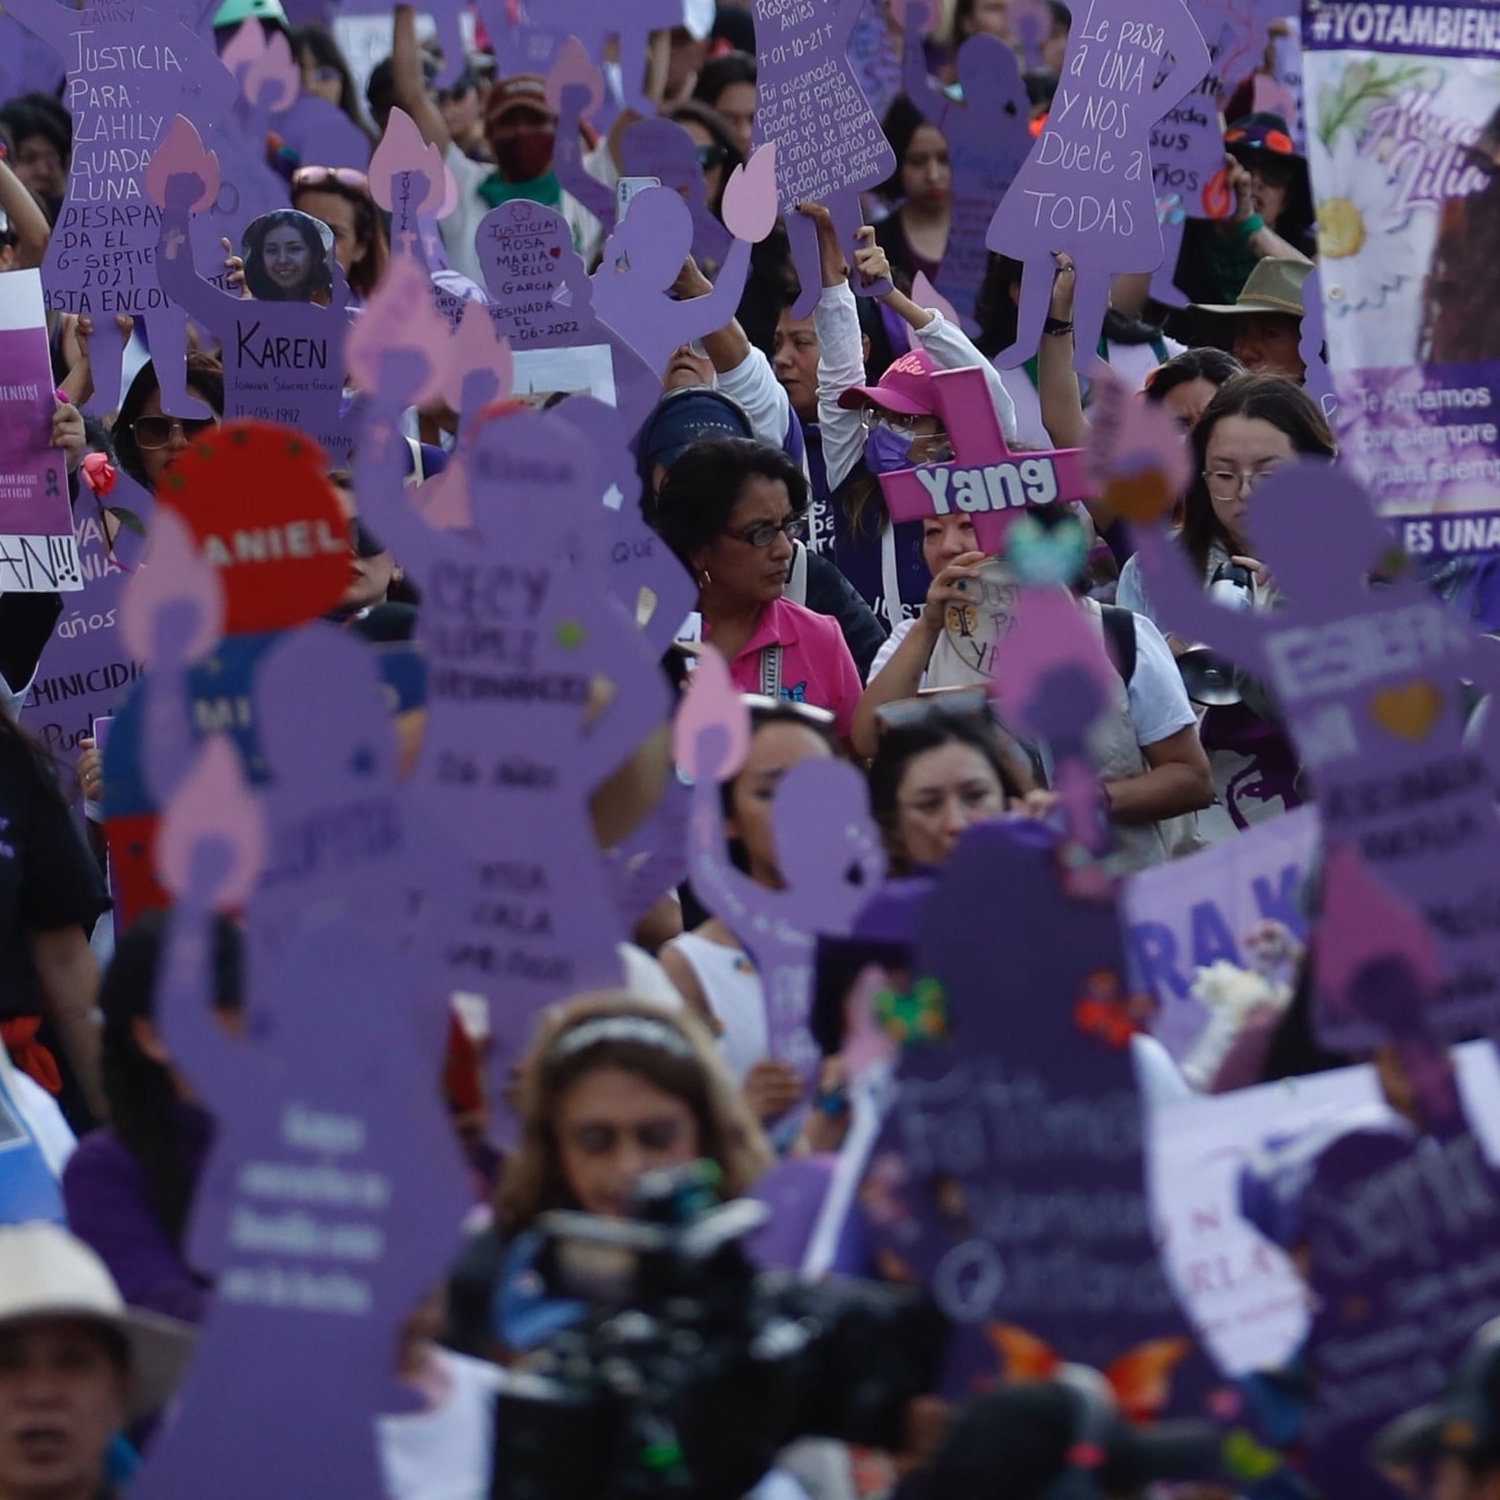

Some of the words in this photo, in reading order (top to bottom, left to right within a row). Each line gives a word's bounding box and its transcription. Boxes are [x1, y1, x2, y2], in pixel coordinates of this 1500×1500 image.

[1118, 21, 1164, 57] pasa
[759, 83, 778, 103] Fui
[781, 57, 838, 96] asesinada
[1071, 43, 1088, 77] a
[1098, 51, 1145, 94] UNA
[757, 106, 778, 127] por
[813, 70, 847, 103] pareja
[73, 113, 163, 143] ZAHILY
[764, 111, 797, 141] padre
[800, 104, 814, 121] de
[1084, 103, 1128, 139] NOS
[1037, 132, 1114, 174] Duele
[1131, 147, 1142, 181] a
[70, 178, 140, 202] LUNA
[1024, 189, 1135, 237] TODAS
[104, 231, 129, 247] EL
[502, 238, 545, 251] ROSA
[83, 267, 135, 288] 2021
[502, 283, 555, 294] GARCIA
[236, 320, 327, 369] KAREN
[915, 455, 1058, 515] Yang
[200, 519, 349, 569] ANIEL
[57, 608, 116, 639] años
